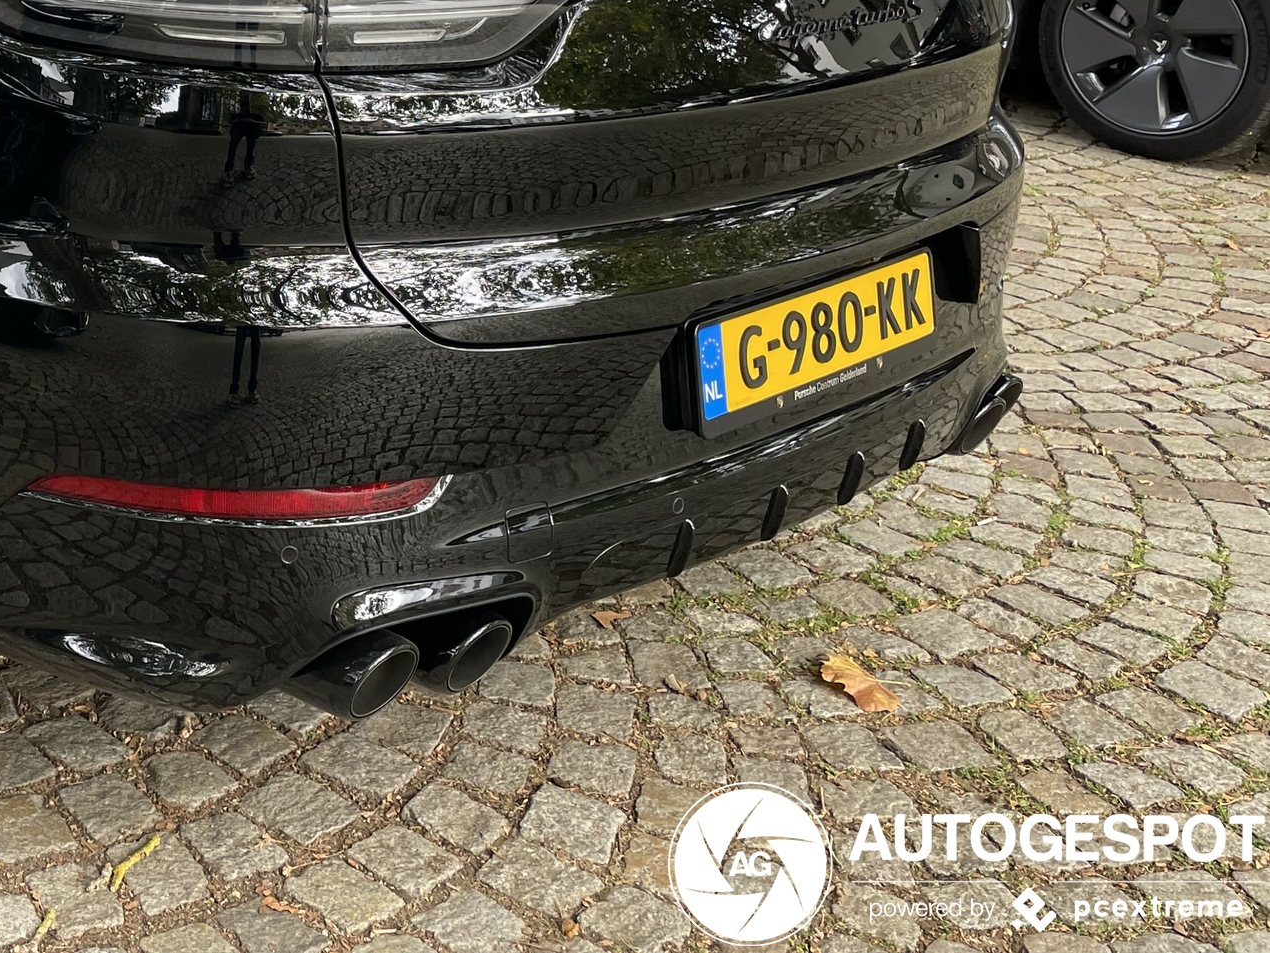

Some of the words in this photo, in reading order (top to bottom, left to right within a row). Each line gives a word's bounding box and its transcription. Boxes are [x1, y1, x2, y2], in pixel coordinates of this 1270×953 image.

[739, 268, 926, 389] G-980-KK
[704, 380, 723, 403] NL
[794, 385, 817, 401] Porsche
[817, 376, 840, 392] Centrum
[839, 363, 867, 383] Gelderland
